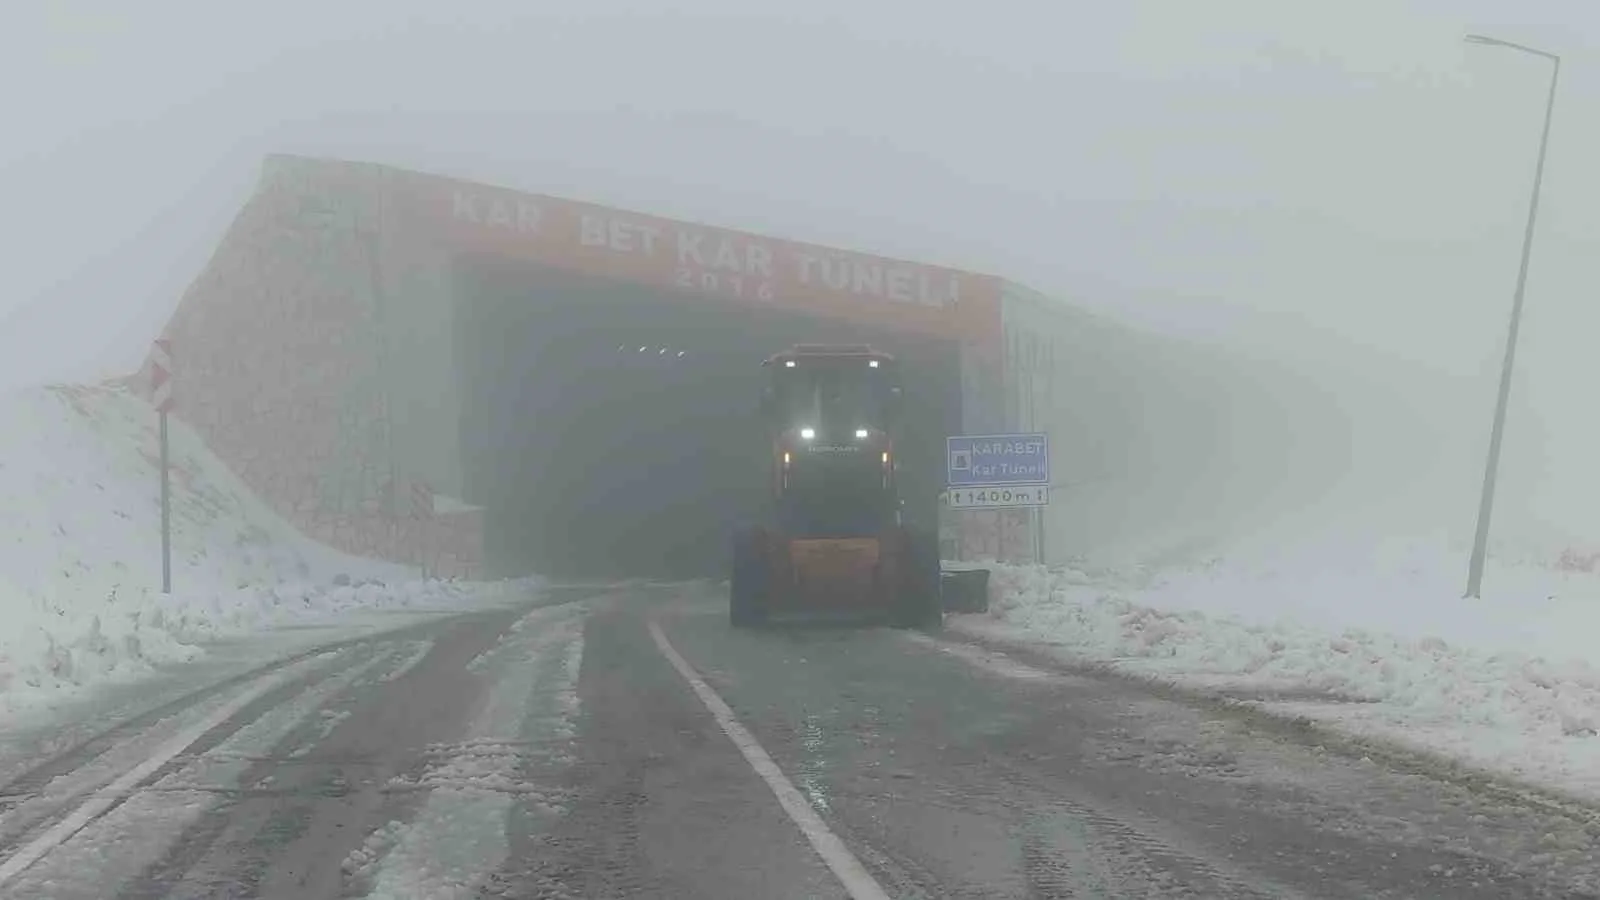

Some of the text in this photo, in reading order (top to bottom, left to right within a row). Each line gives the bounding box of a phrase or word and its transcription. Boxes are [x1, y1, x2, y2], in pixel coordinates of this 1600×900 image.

[453, 189, 541, 233] KAR
[580, 214, 659, 256] BET
[677, 230, 773, 278] KAR
[971, 440, 1044, 456] KARABET
[972, 463, 997, 477] Kar
